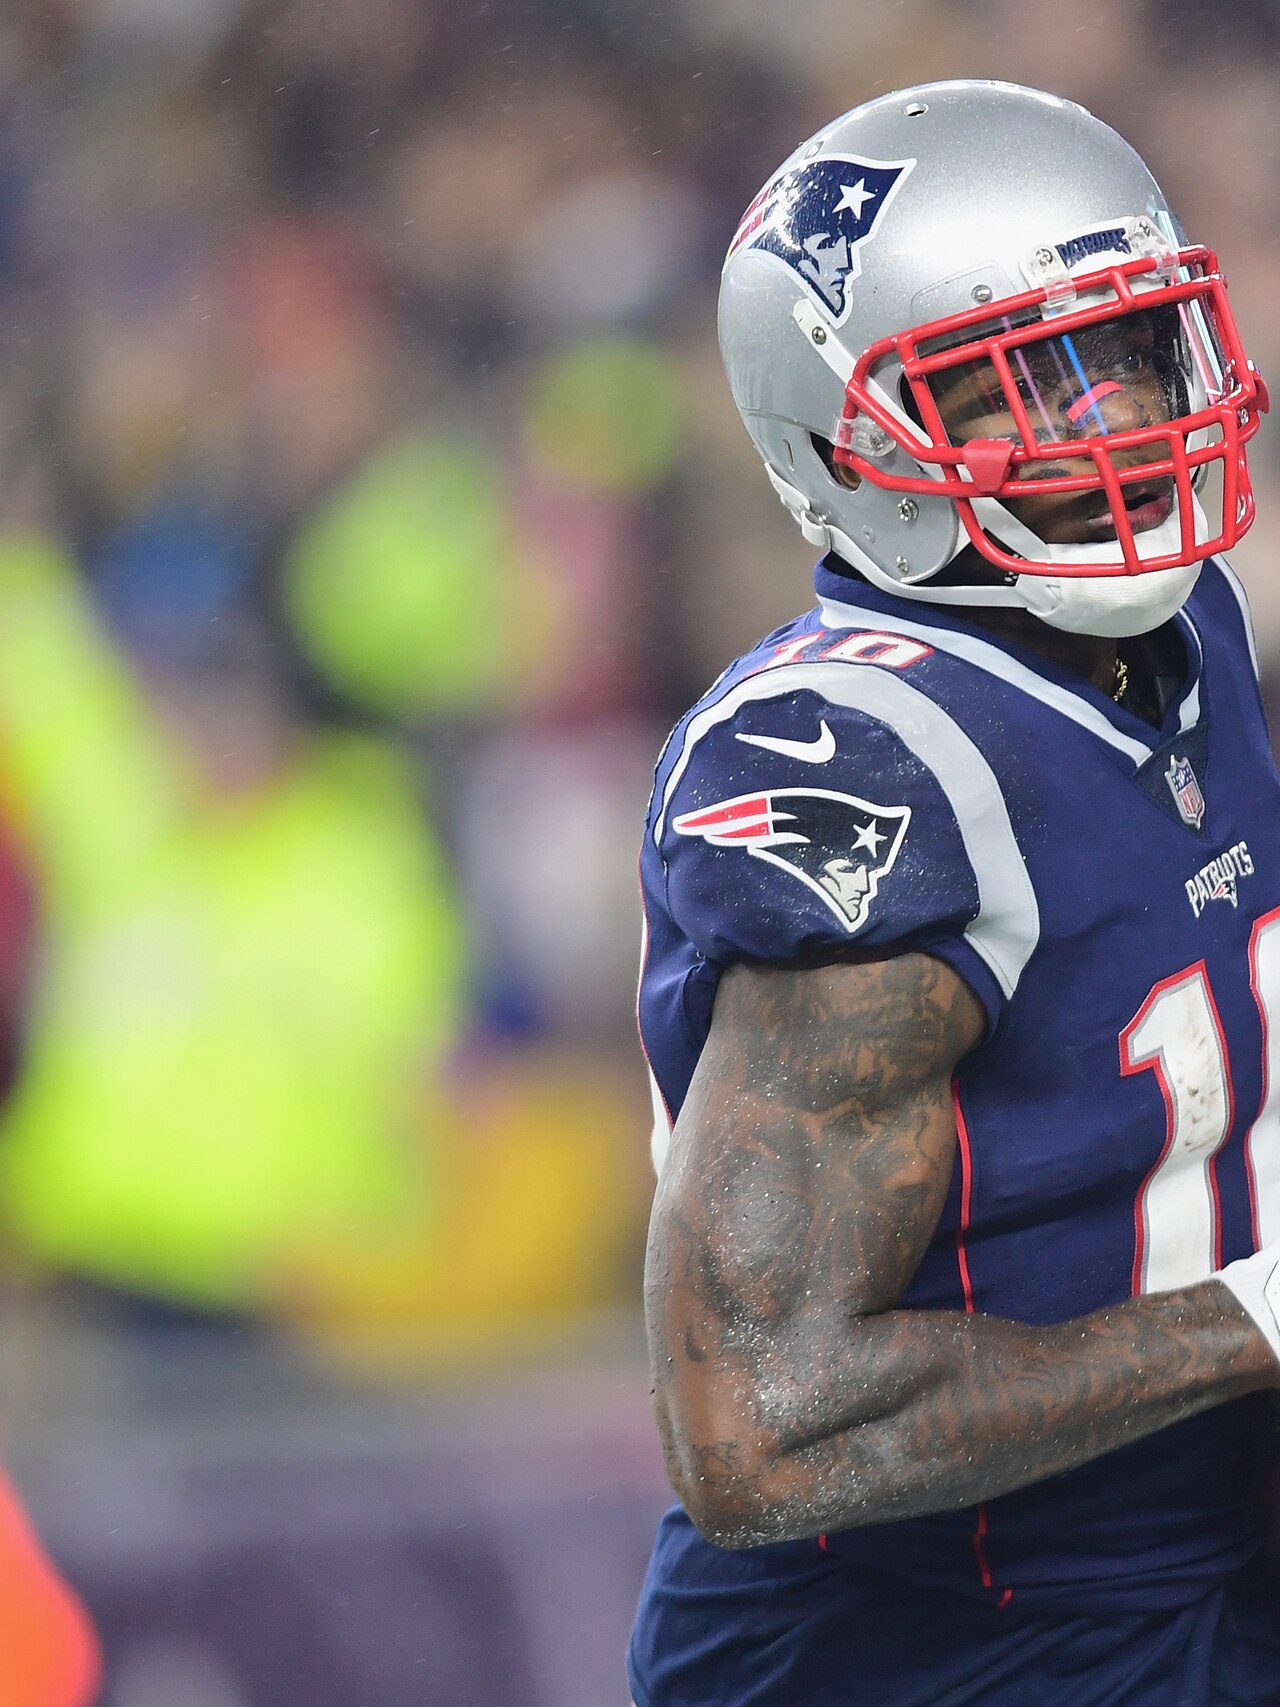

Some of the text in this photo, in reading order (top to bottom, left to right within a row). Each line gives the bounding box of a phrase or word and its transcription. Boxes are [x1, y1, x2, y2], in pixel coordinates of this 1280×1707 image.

[1055, 227, 1132, 270] PATRIOTS
[743, 630, 935, 677] 10
[1185, 841, 1254, 918] PATRIOTS
